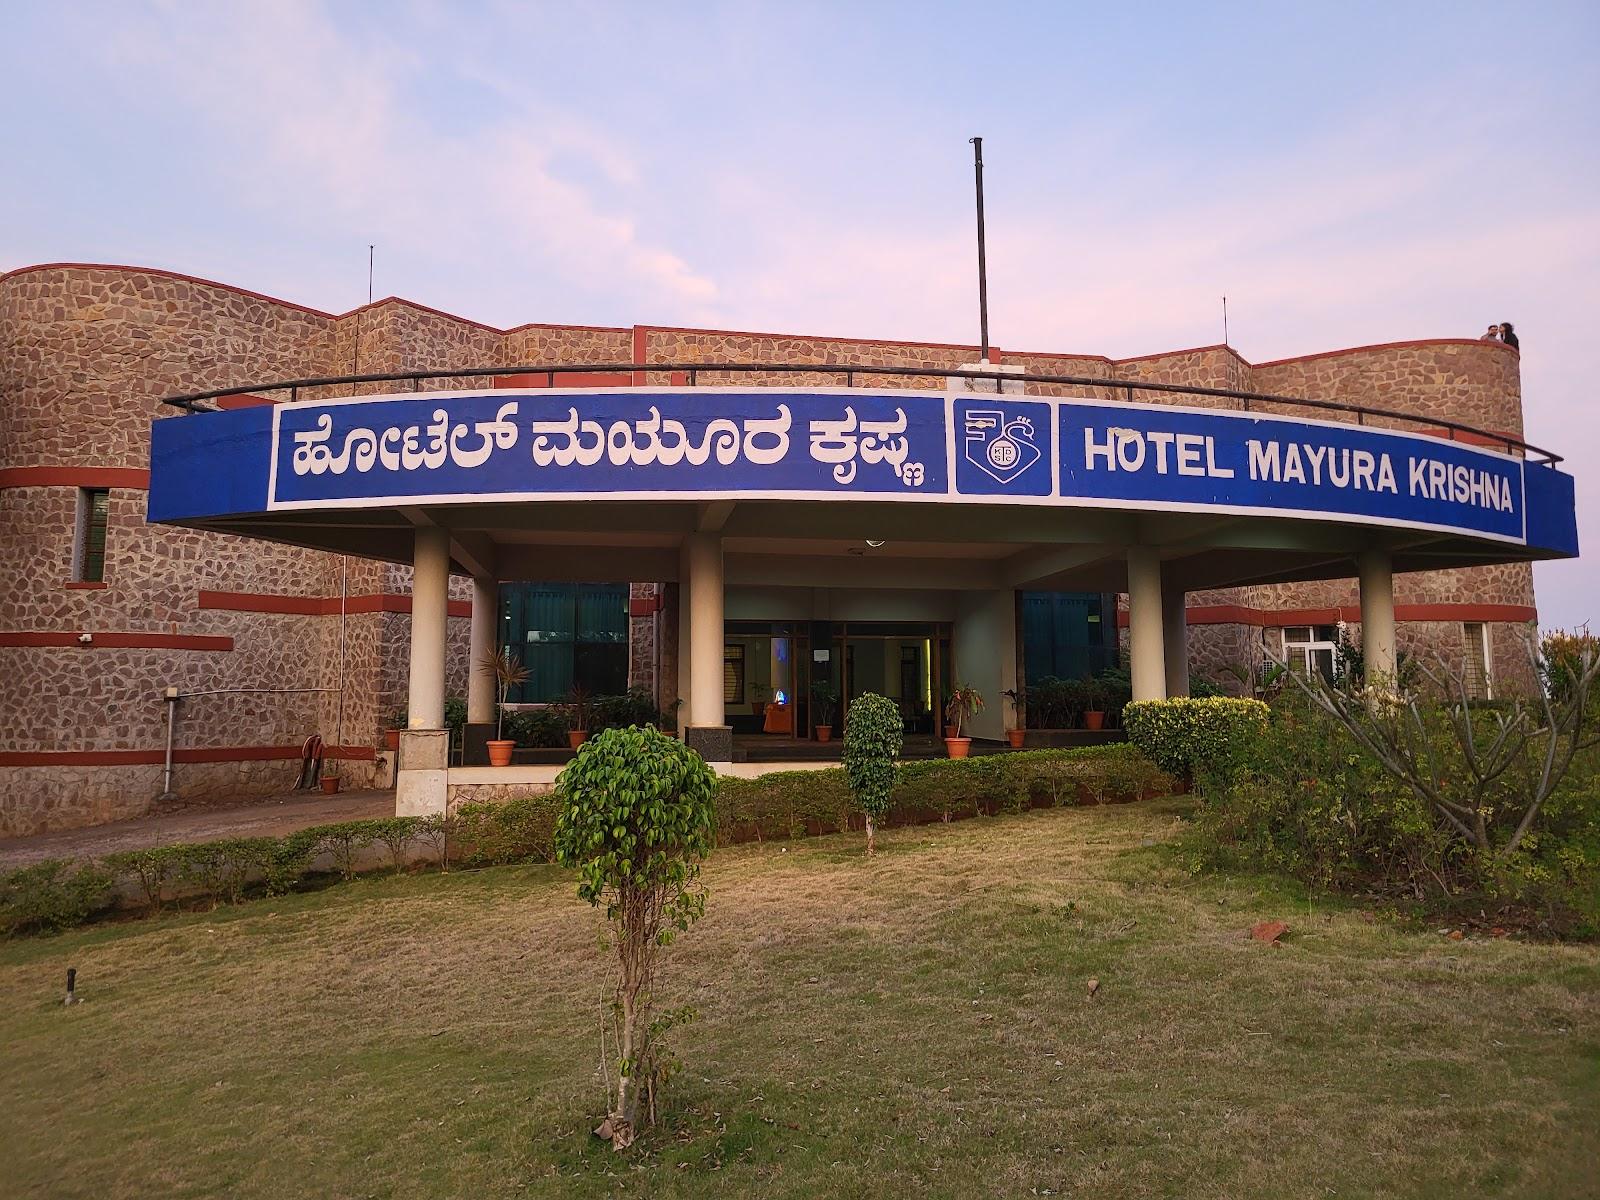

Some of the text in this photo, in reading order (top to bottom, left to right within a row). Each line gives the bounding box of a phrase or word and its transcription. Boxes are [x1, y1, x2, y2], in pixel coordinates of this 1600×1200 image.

[293, 402, 925, 487] ಹೋಟೆಲ್ ಮಯೂರ ಕೃಷ್ಣ
[1084, 427, 1514, 514] HOTEL MAYURA KRISHNA
